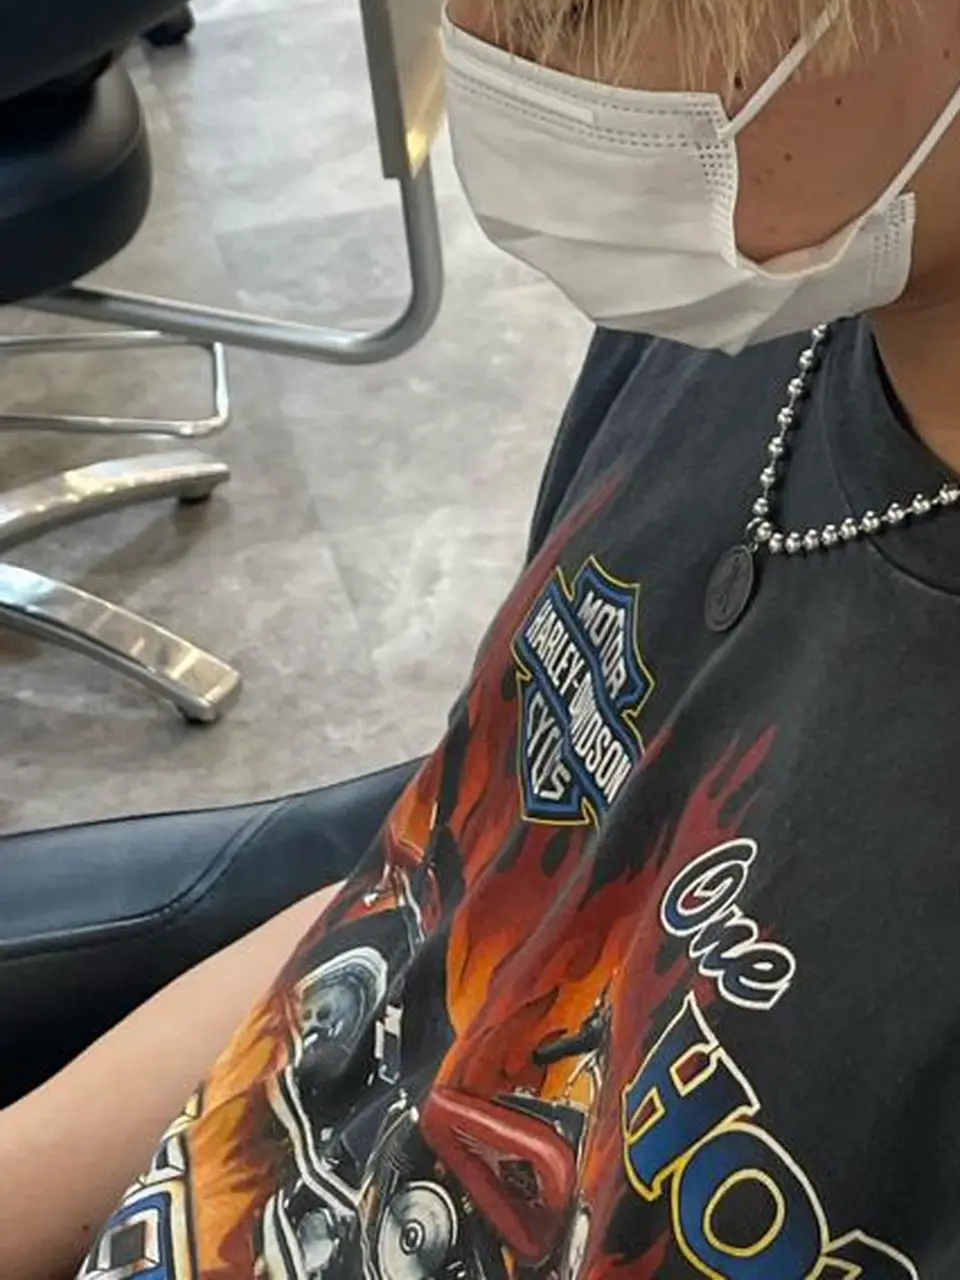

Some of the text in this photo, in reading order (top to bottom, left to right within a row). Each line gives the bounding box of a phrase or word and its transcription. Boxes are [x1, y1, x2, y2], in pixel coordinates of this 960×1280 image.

[525, 599, 632, 803] HARLEY-DIDSON
[577, 592, 627, 699] MOTOR
[528, 693, 571, 800] CYCLS
[661, 838, 796, 1009] One
[622, 990, 918, 1280] HO
